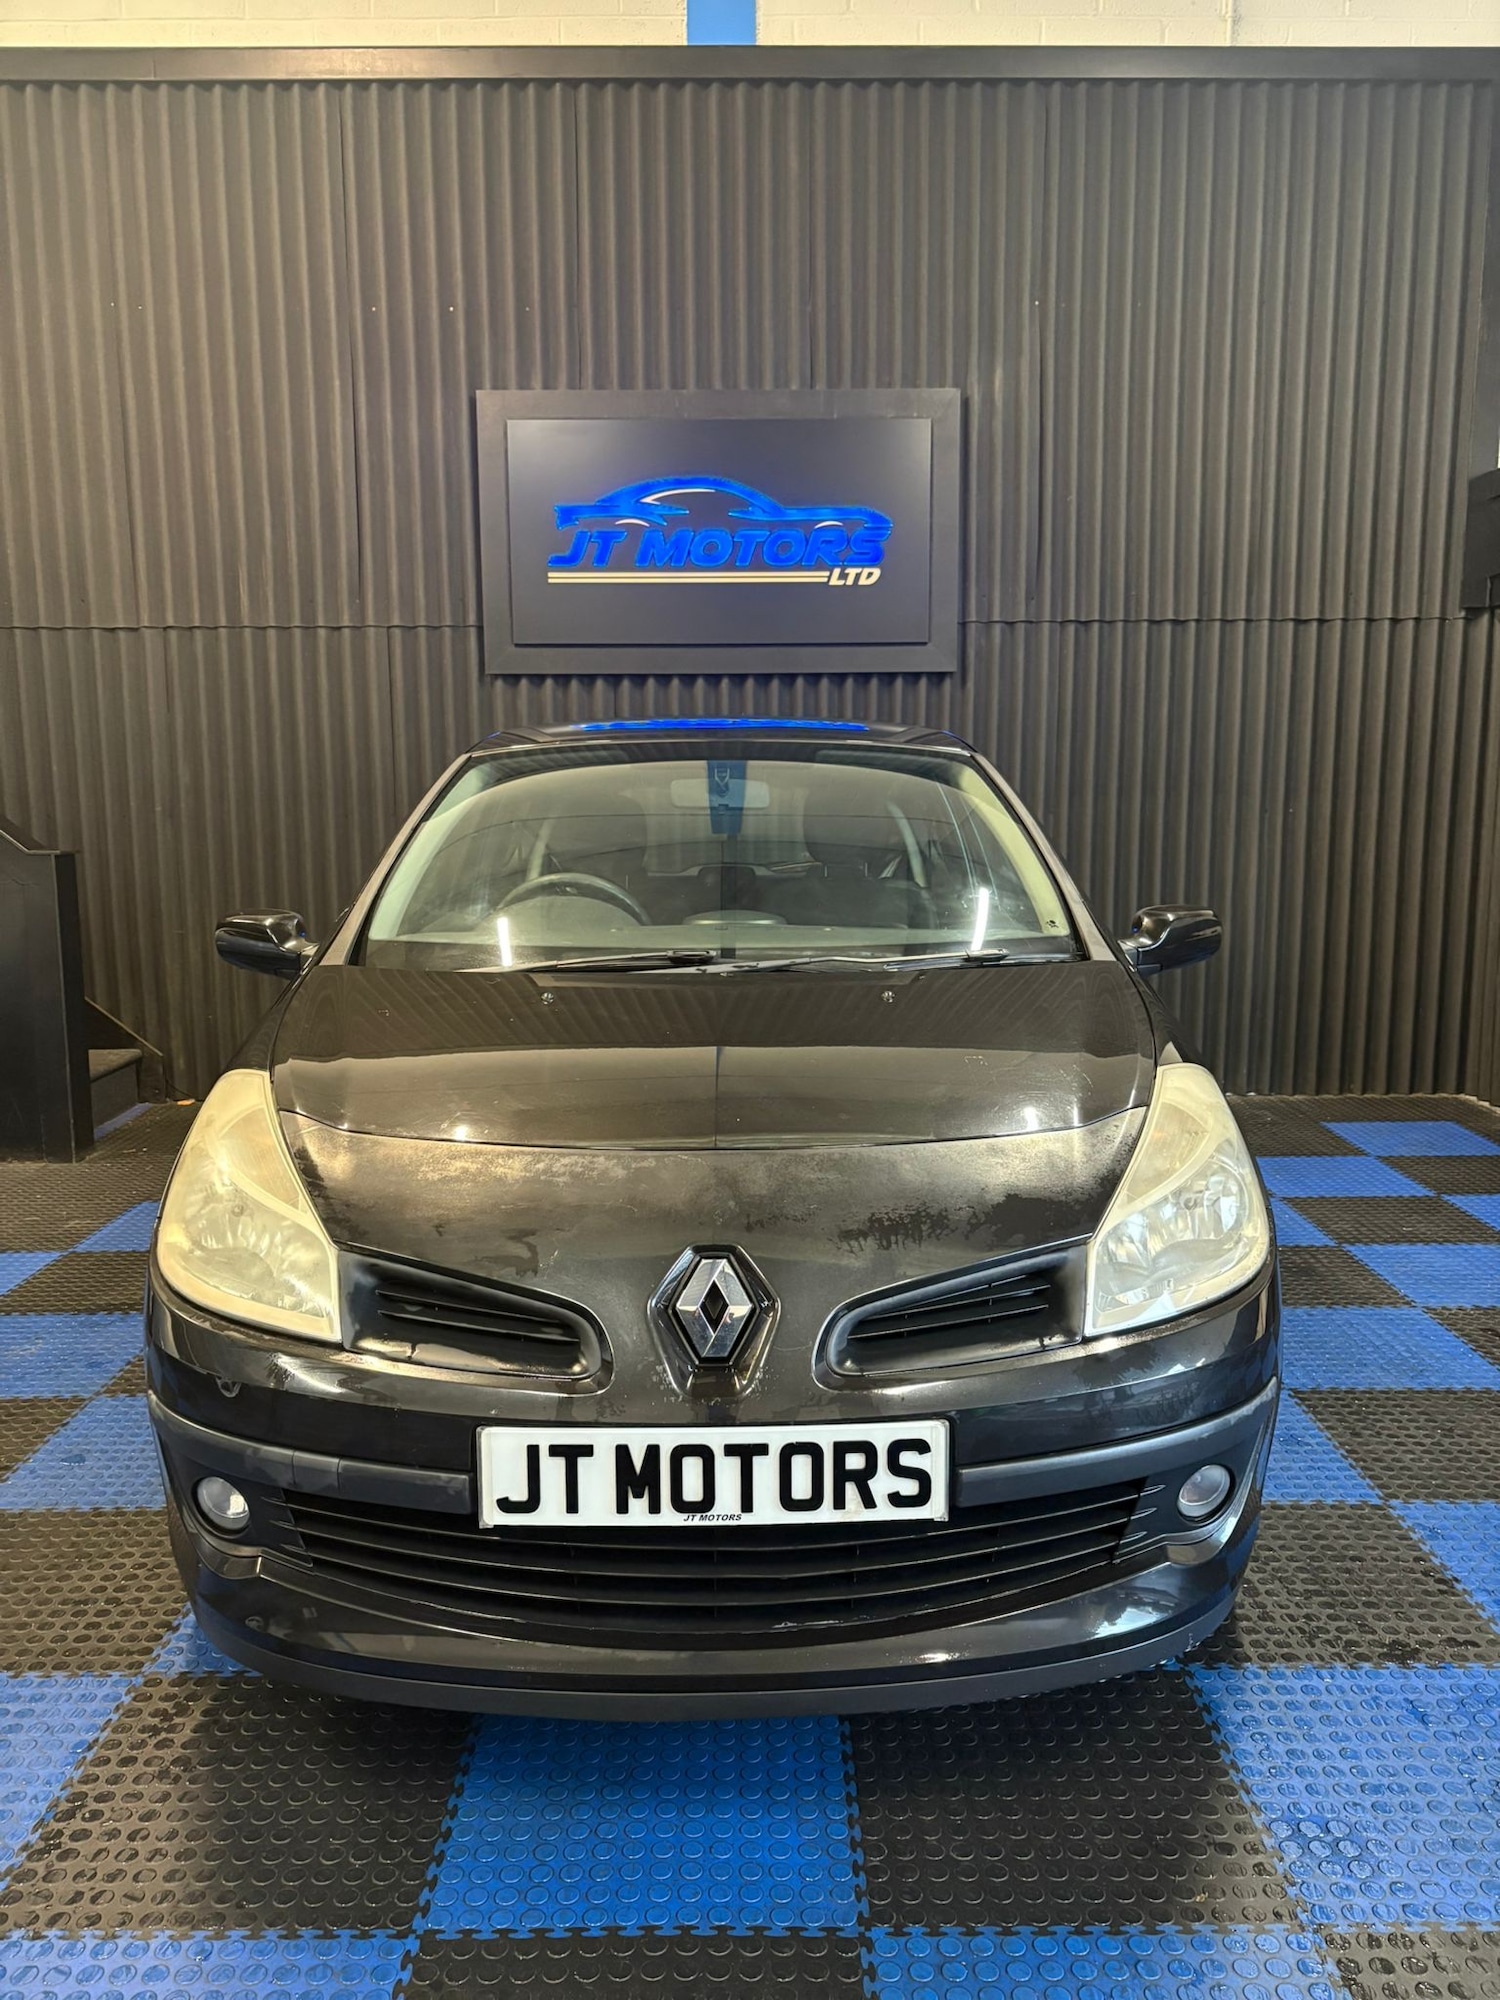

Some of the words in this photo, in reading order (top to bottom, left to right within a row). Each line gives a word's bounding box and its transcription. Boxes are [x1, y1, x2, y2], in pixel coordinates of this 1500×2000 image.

[547, 530, 627, 567] JT
[634, 529, 892, 567] MOTORS
[828, 567, 882, 586] LTD
[496, 1444, 594, 1515] JT
[614, 1438, 933, 1515] MOTORS
[683, 1514, 697, 1522] JT
[698, 1513, 742, 1522] MOTORS
